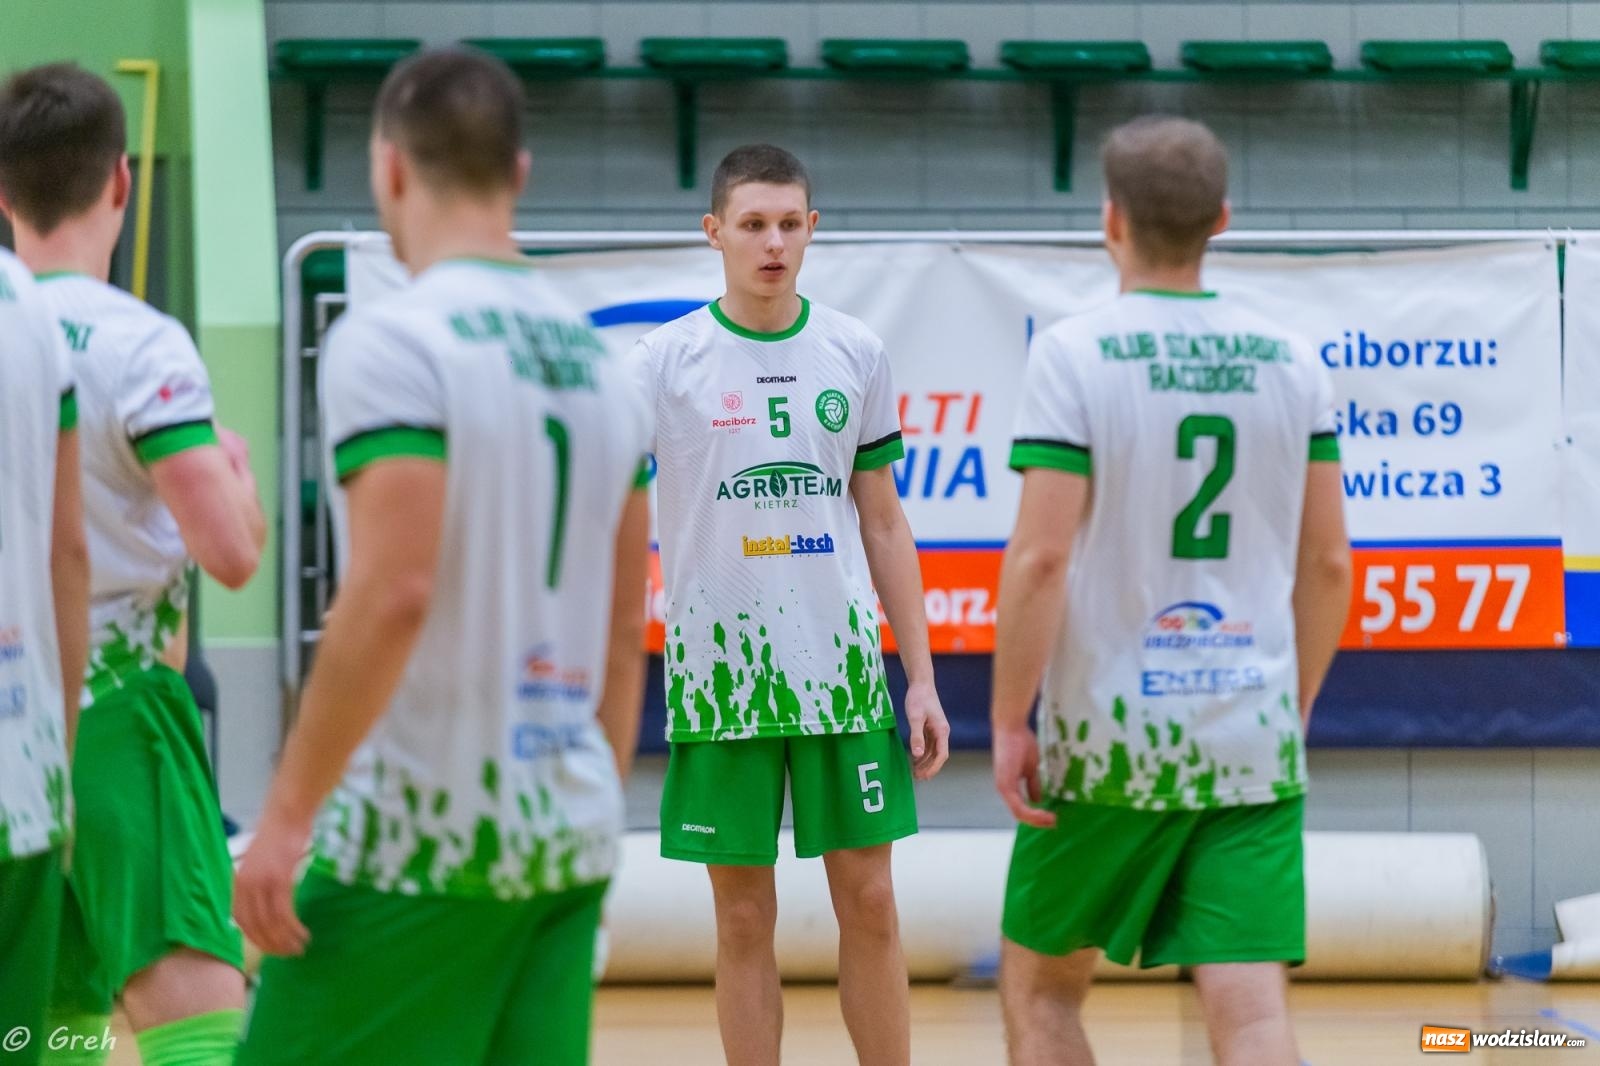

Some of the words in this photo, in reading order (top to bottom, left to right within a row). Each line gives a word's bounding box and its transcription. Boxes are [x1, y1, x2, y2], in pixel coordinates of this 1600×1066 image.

[1320, 330, 1497, 368] ciborzu:
[756, 376, 797, 384] DECATHLON
[712, 416, 757, 428] Racibórz
[768, 396, 791, 438] 5
[898, 393, 984, 434] LTI
[1334, 400, 1398, 437] ska
[1412, 402, 1463, 436] 69
[892, 446, 988, 499] NIA
[1171, 414, 1236, 559] 2
[1342, 461, 1465, 498] wicza
[1480, 463, 1502, 497] 3
[754, 499, 798, 511] KIETRZ
[1360, 564, 1437, 633] 55
[1455, 563, 1532, 632] 77
[857, 761, 885, 814] 5
[681, 823, 716, 834] DECATHLON
